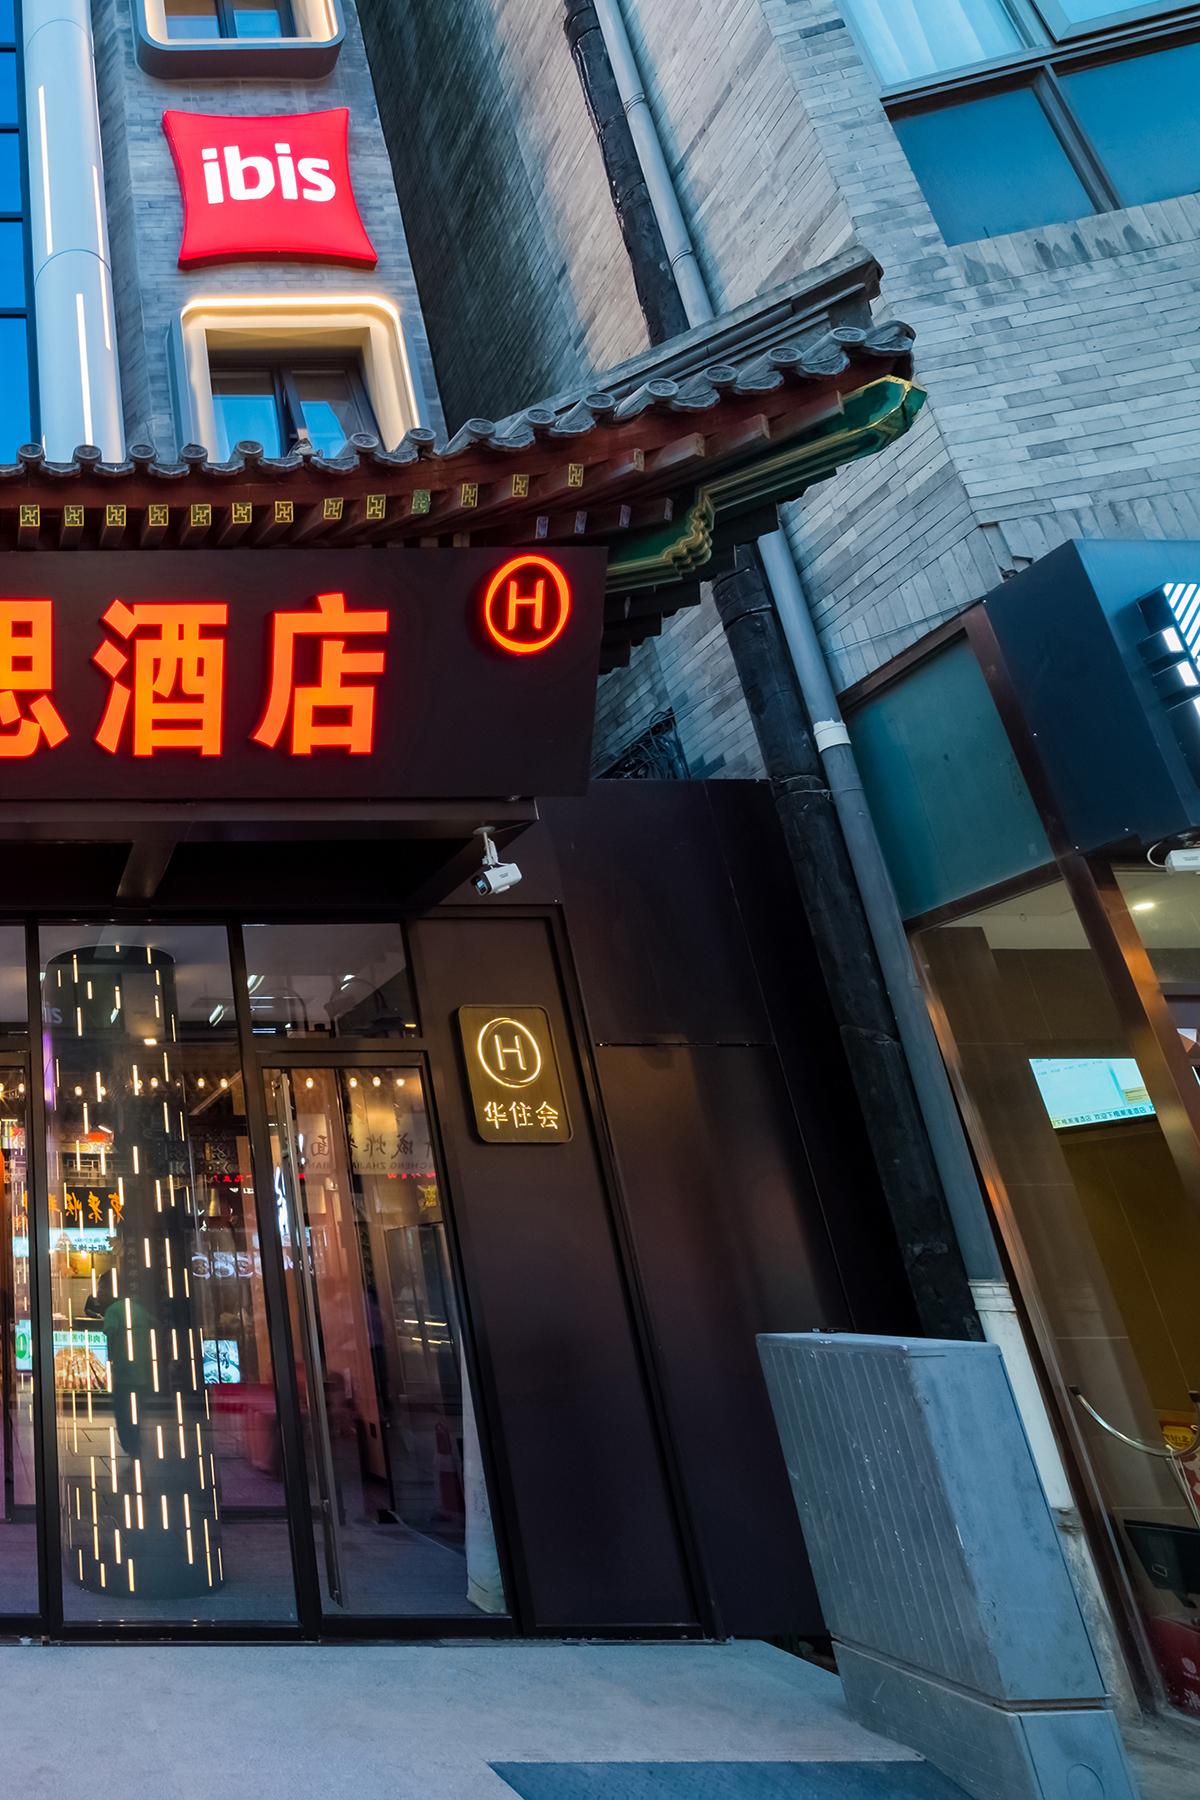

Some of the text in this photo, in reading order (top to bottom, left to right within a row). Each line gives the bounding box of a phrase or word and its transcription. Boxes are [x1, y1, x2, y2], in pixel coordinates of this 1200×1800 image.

[201, 143, 337, 205] ibis
[483, 1101, 559, 1130] 华住会
